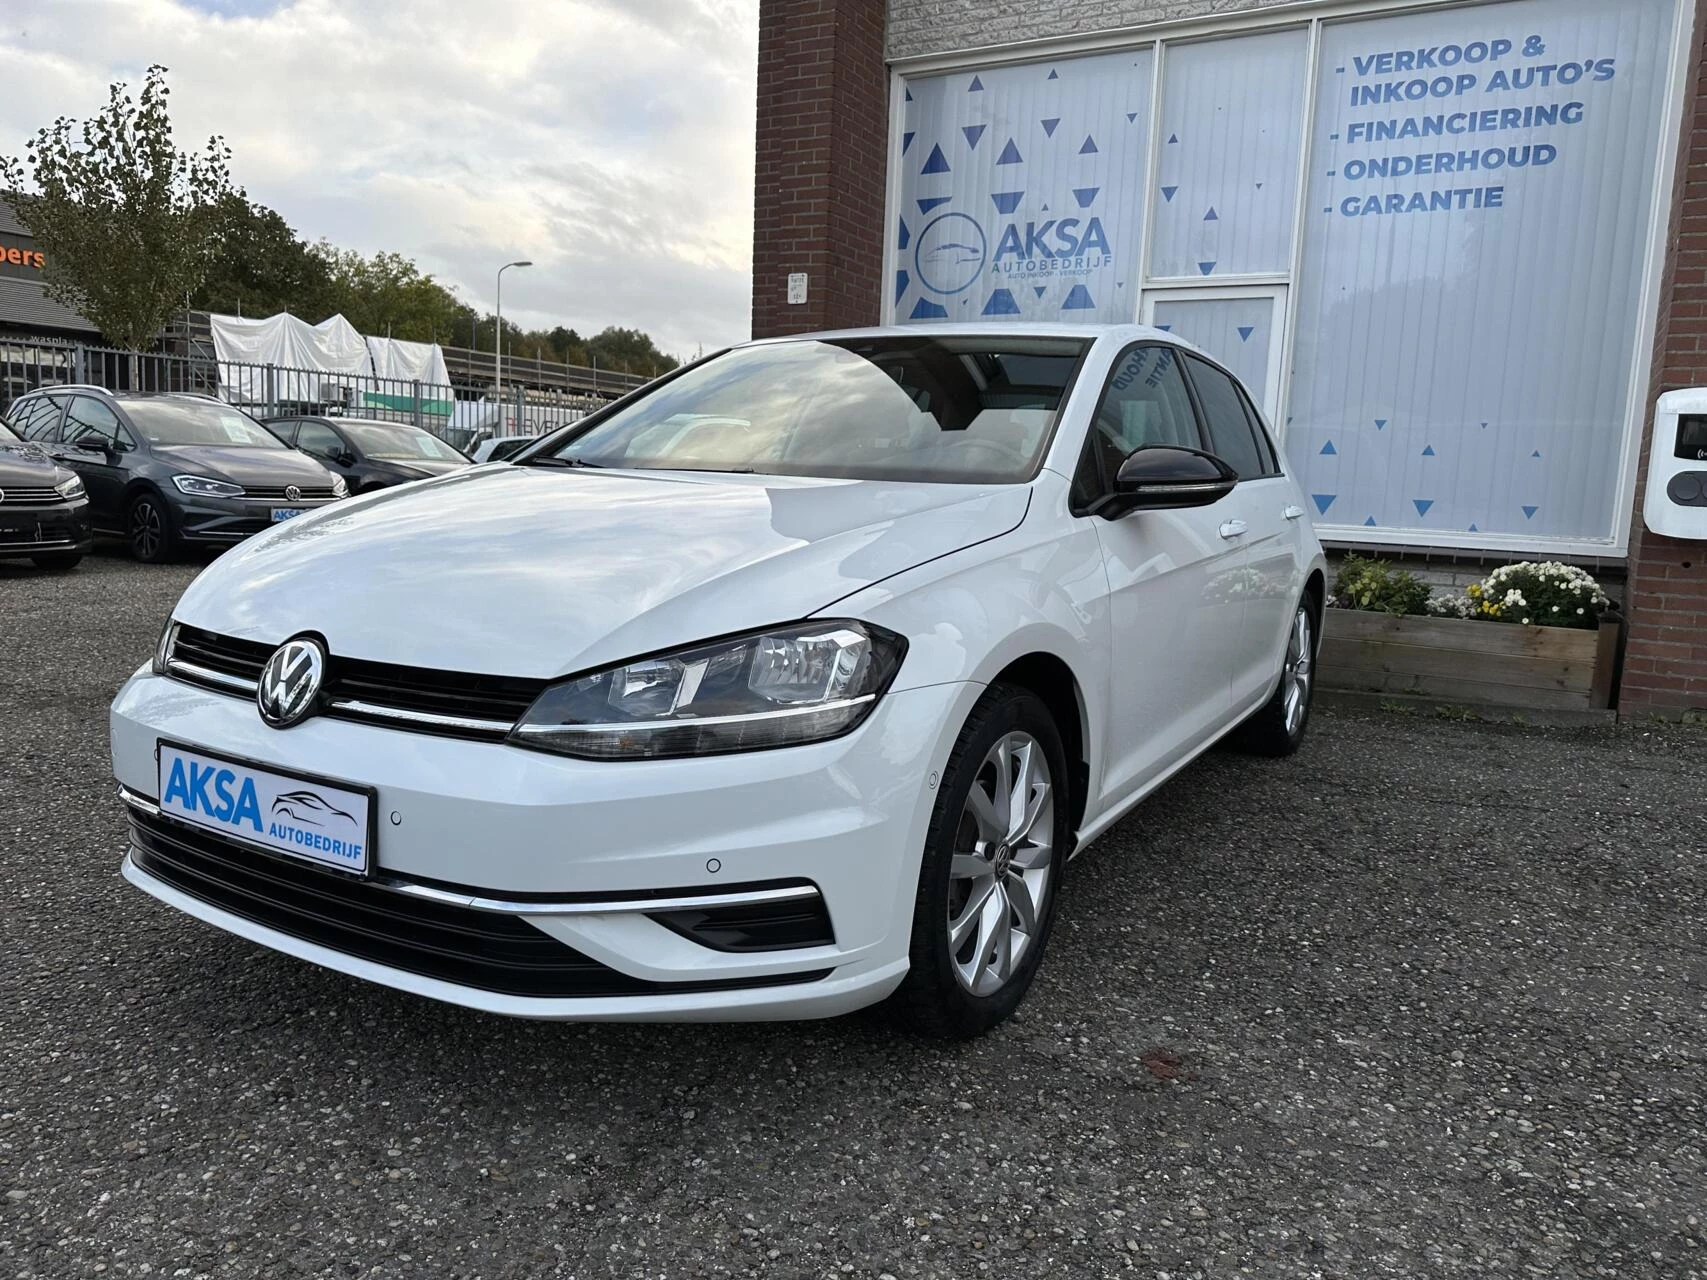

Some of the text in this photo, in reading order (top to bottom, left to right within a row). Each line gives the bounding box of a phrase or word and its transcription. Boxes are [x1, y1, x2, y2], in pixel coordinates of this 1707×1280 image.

[1353, 38, 1512, 76] VERKOOP
[1522, 34, 1546, 57] &
[1350, 58, 1616, 107] INKOOP AUTO'S
[1347, 101, 1584, 144] FINANCIERING
[1343, 144, 1557, 180] ONDERHOUD
[1340, 186, 1504, 217] GARANTIE
[992, 217, 1112, 262] AKSA
[991, 256, 1112, 274] AUTOBEDRIJF
[1008, 272, 1026, 280] AUTO
[1027, 270, 1054, 279] INKOOP
[1060, 268, 1093, 277] VERKOOP
[164, 757, 264, 833] AKSA
[269, 822, 362, 860] AUTOBEDRIJF
